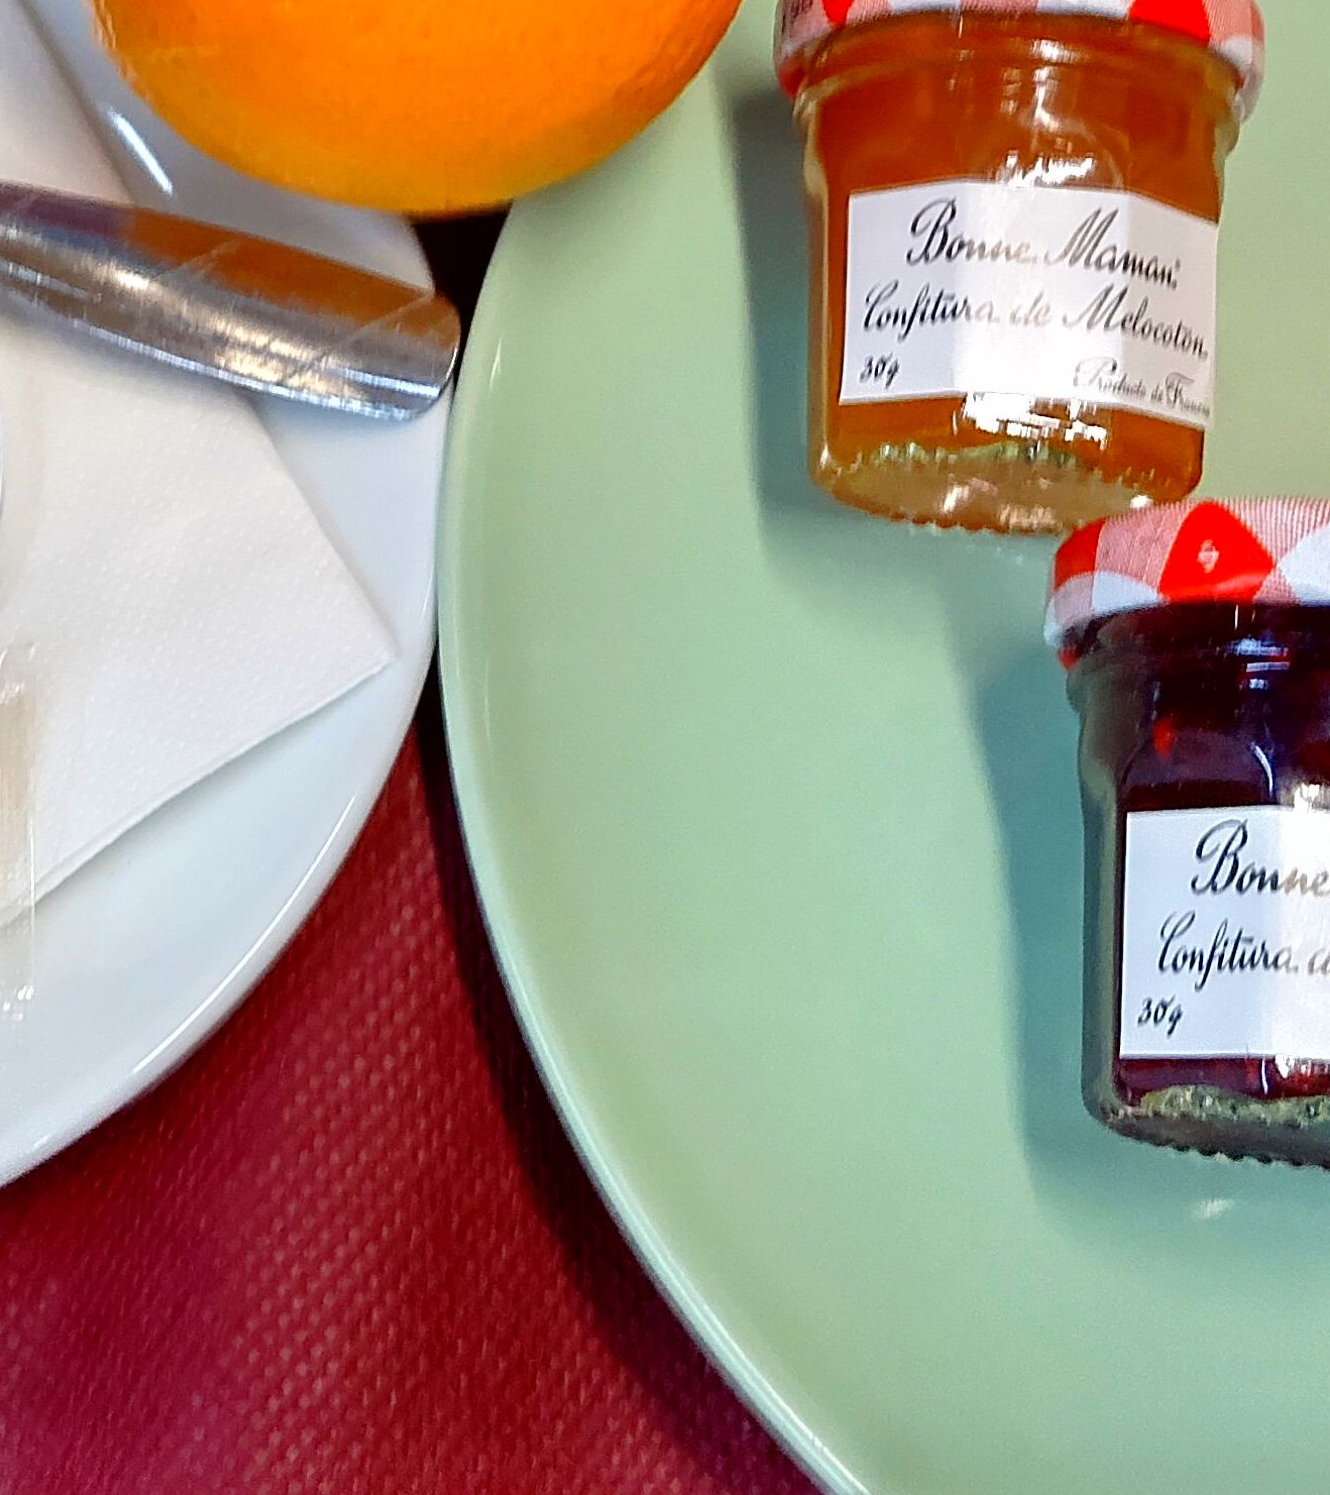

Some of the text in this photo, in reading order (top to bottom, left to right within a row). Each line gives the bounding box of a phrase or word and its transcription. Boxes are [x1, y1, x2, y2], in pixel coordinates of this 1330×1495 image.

[906, 196, 1177, 289] Bonne Maman
[863, 279, 1001, 343] Confitura
[1004, 292, 1051, 327] de
[859, 355, 900, 390] 30g
[1157, 911, 1299, 992] Confitura
[1137, 996, 1184, 1039] 30g
